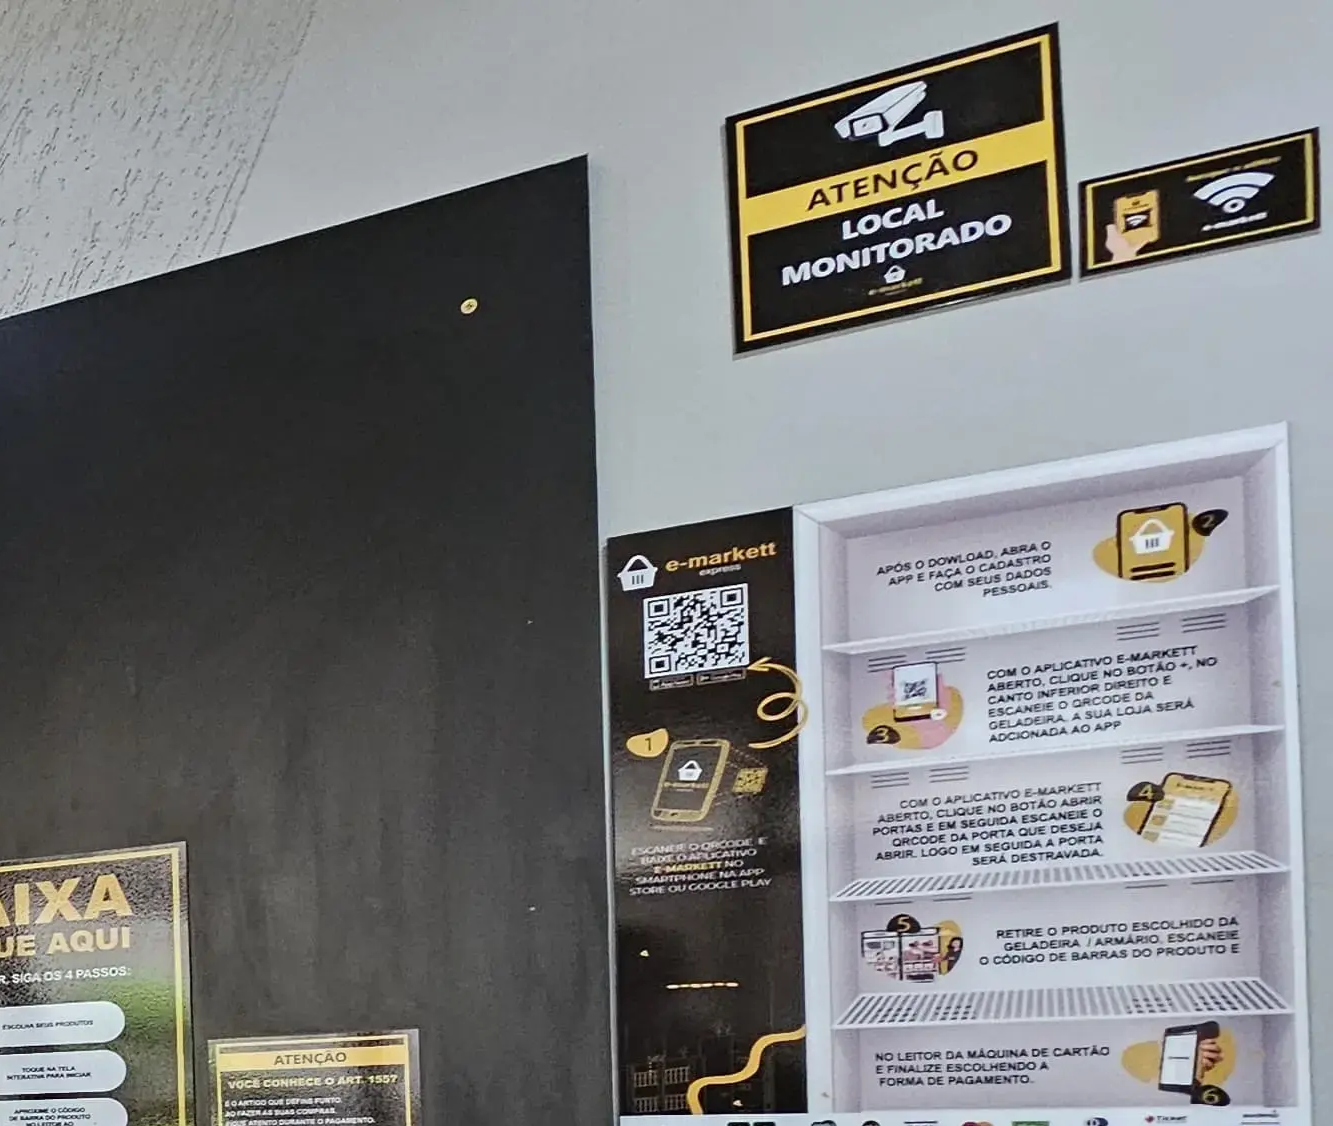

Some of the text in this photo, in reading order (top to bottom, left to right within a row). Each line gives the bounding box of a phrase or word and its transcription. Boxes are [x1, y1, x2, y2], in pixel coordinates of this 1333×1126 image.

[807, 148, 980, 212] ATENÇÃO
[841, 200, 945, 241] LOCAL
[781, 214, 1013, 286] MONITORADO
[1201, 514, 1215, 528] 2
[665, 541, 778, 572] e-markett
[876, 561, 911, 575] APÓS
[1000, 542, 1037, 556] ABRA
[887, 574, 913, 585] APP
[928, 566, 962, 580] FAÇA
[978, 553, 1051, 572] CADASTRO
[933, 566, 1051, 591] COM SEUS DADOS
[875, 729, 889, 743] 3
[897, 917, 911, 932] 5
[996, 927, 1043, 938] RETIRE
[1061, 922, 1127, 935] PRODUTO
[1131, 918, 1214, 931] ESCOLHIDO
[1218, 916, 1239, 926] DA
[47, 926, 131, 955] AQUI
[1003, 938, 1080, 951] GELADEIRA
[1167, 930, 1238, 942] ESCANEIE
[992, 953, 1045, 964] CÓDIGO
[1048, 952, 1066, 961] DE
[1071, 949, 1127, 960] BARRAS
[1131, 948, 1152, 958] DO
[1156, 944, 1226, 956] PRODUTO
[12, 972, 41, 985] SIGA
[43, 970, 62, 982] OS
[64, 970, 73, 980] 4
[76, 966, 132, 979] PASSOS:
[274, 1051, 347, 1066] ATENÇÃO
[874, 1046, 1110, 1061] NO LEITOR DA MÁQUINA DE CARTÃO
[886, 1063, 942, 1073] FINALIZE
[945, 1061, 1036, 1072] ESCOLHENDO
[264, 1075, 322, 1088] CONHECE
[324, 1076, 334, 1085] O
[878, 1077, 924, 1086] FORMA
[927, 1076, 944, 1085] DE
